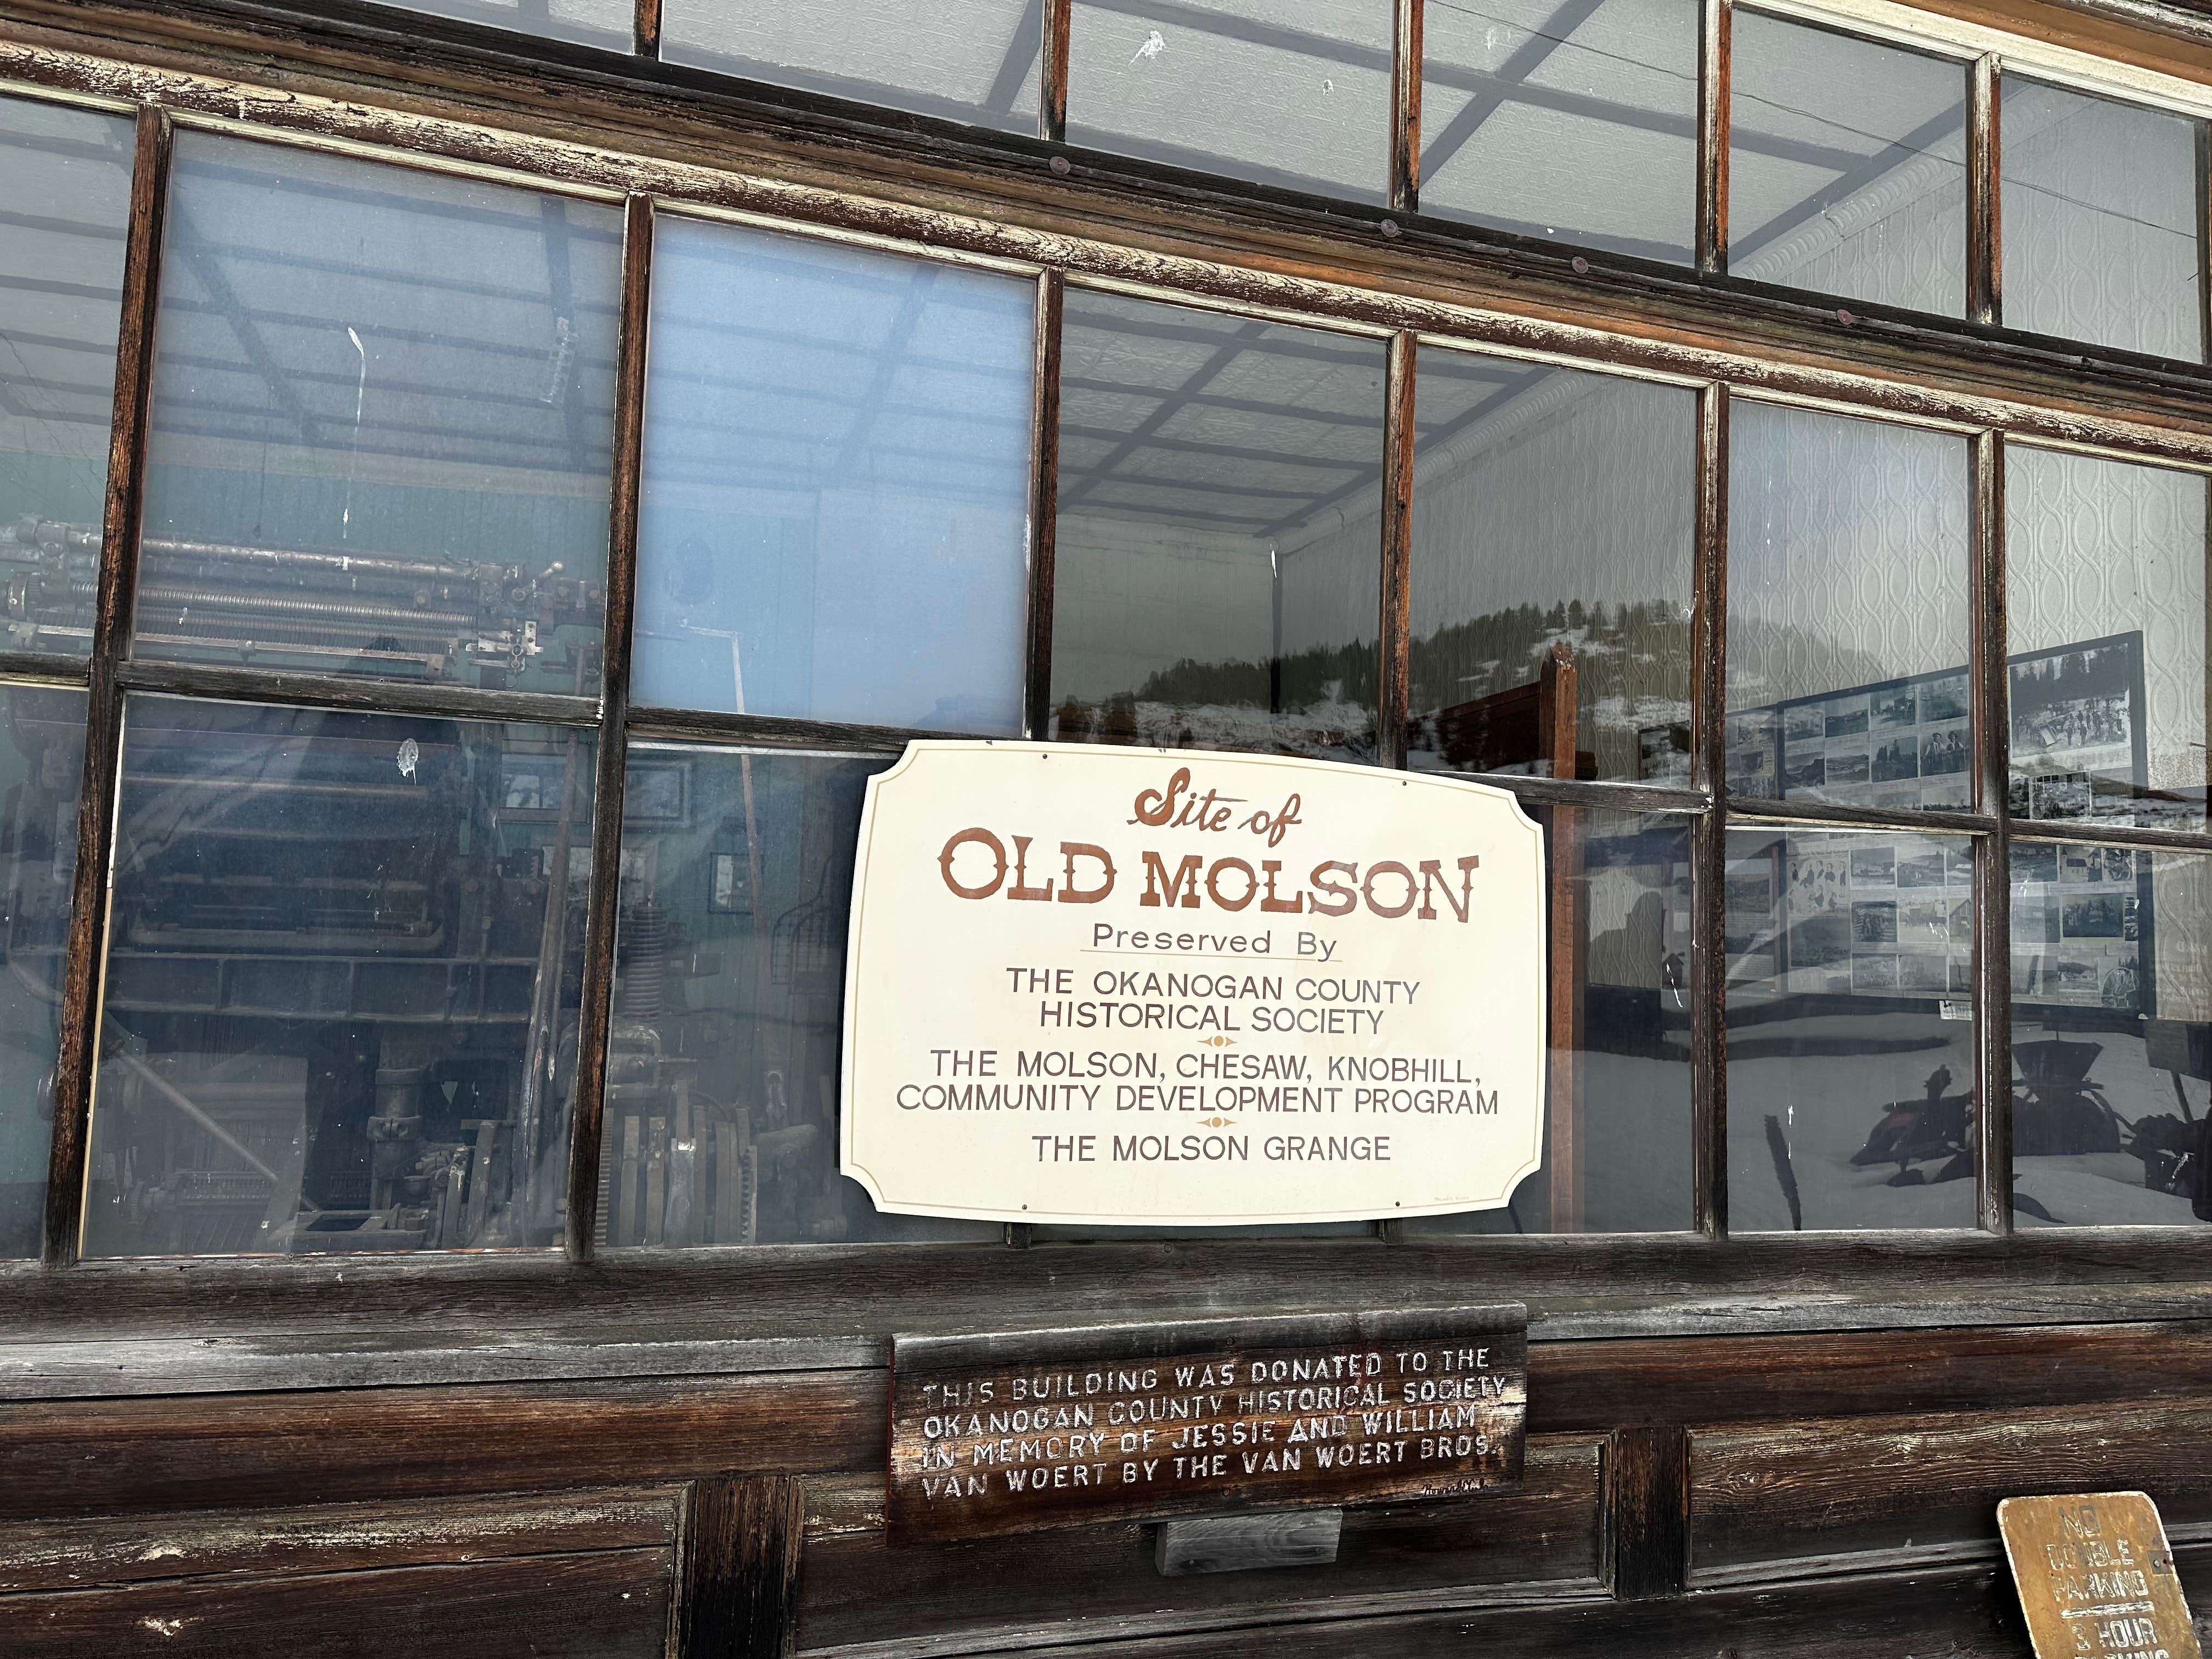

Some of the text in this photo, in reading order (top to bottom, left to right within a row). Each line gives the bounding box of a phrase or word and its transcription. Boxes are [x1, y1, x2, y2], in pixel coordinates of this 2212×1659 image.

[1126, 768, 1302, 848] Site of
[937, 827, 1480, 923] OLD MOLSON
[1093, 923, 1337, 962] Preserved By
[1006, 967, 1420, 1005] THE OKANOGAN COUNTY
[1040, 1001, 1384, 1035] HISTORICAL SOCIETY
[930, 1049, 1481, 1087] THE MOLSON, CHESAW, KNOBHILL,
[896, 1084, 1498, 1115] COMMUNITY DEVELOPMENT PROGRAM
[1031, 1135, 1391, 1162] THE MOLSON GRANGE
[923, 1347, 1491, 1409] THIS BUILDING WAS DONATED TO THE
[923, 1375, 1506, 1439] OKANOGAN COUNTY HISTORICAL SOCIETY
[922, 1404, 1476, 1469] IN MEMORY OF JESSIE AND WILLIAM
[921, 1435, 1498, 1500] VAN WOERT BY THE VAN WOERT BROS.
[2057, 1504, 2102, 1537] NO
[2050, 1570, 2149, 1602] PARKING
[2095, 1618, 2158, 1648] HOUR
